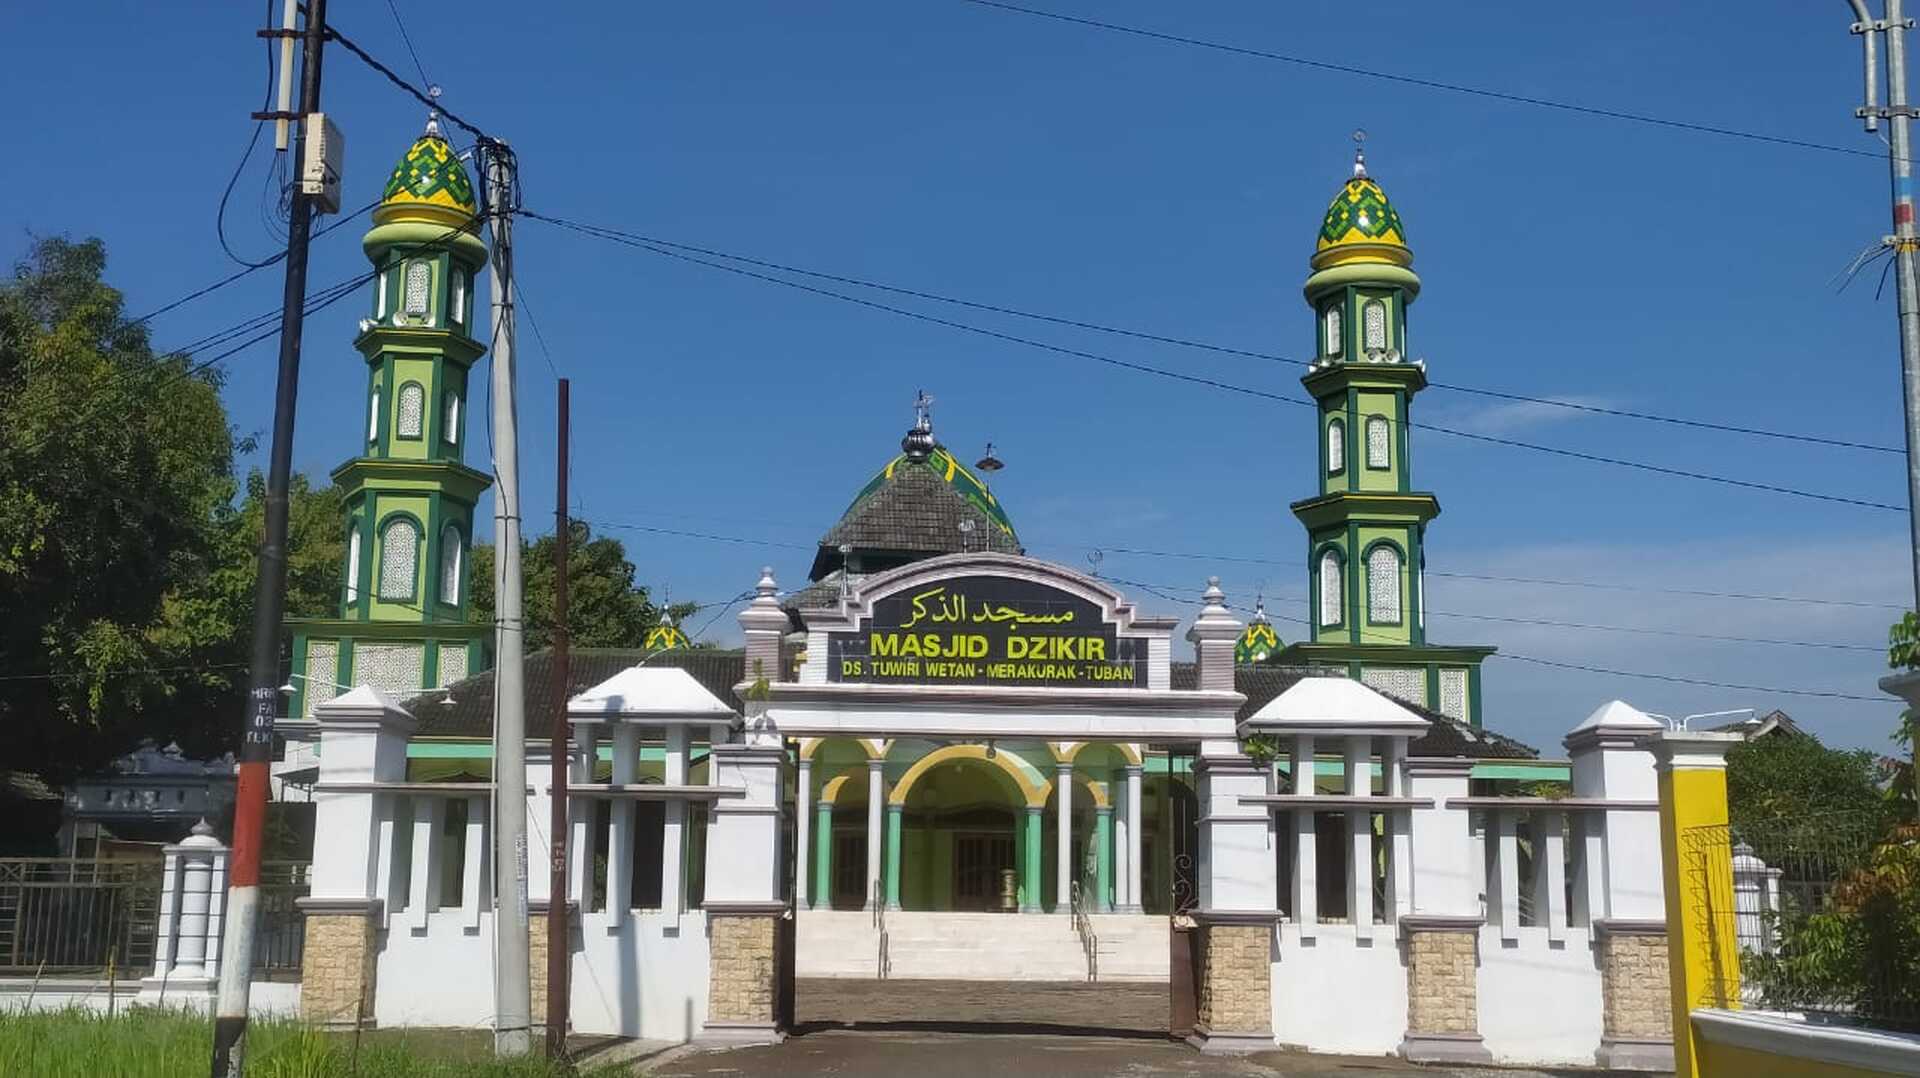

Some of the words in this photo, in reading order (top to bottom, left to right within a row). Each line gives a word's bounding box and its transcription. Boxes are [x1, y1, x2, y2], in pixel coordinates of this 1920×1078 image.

[900, 587, 965, 628] الذكر
[972, 602, 1074, 631] مسجد
[870, 633, 989, 658] MASJID
[1007, 636, 1105, 661] DZIKIR
[842, 661, 867, 676] DS.
[871, 661, 920, 677] TUWIRI
[926, 662, 975, 678] WETAN
[986, 664, 1077, 680] MERAKURAK
[1085, 666, 1133, 681] TUBAN
